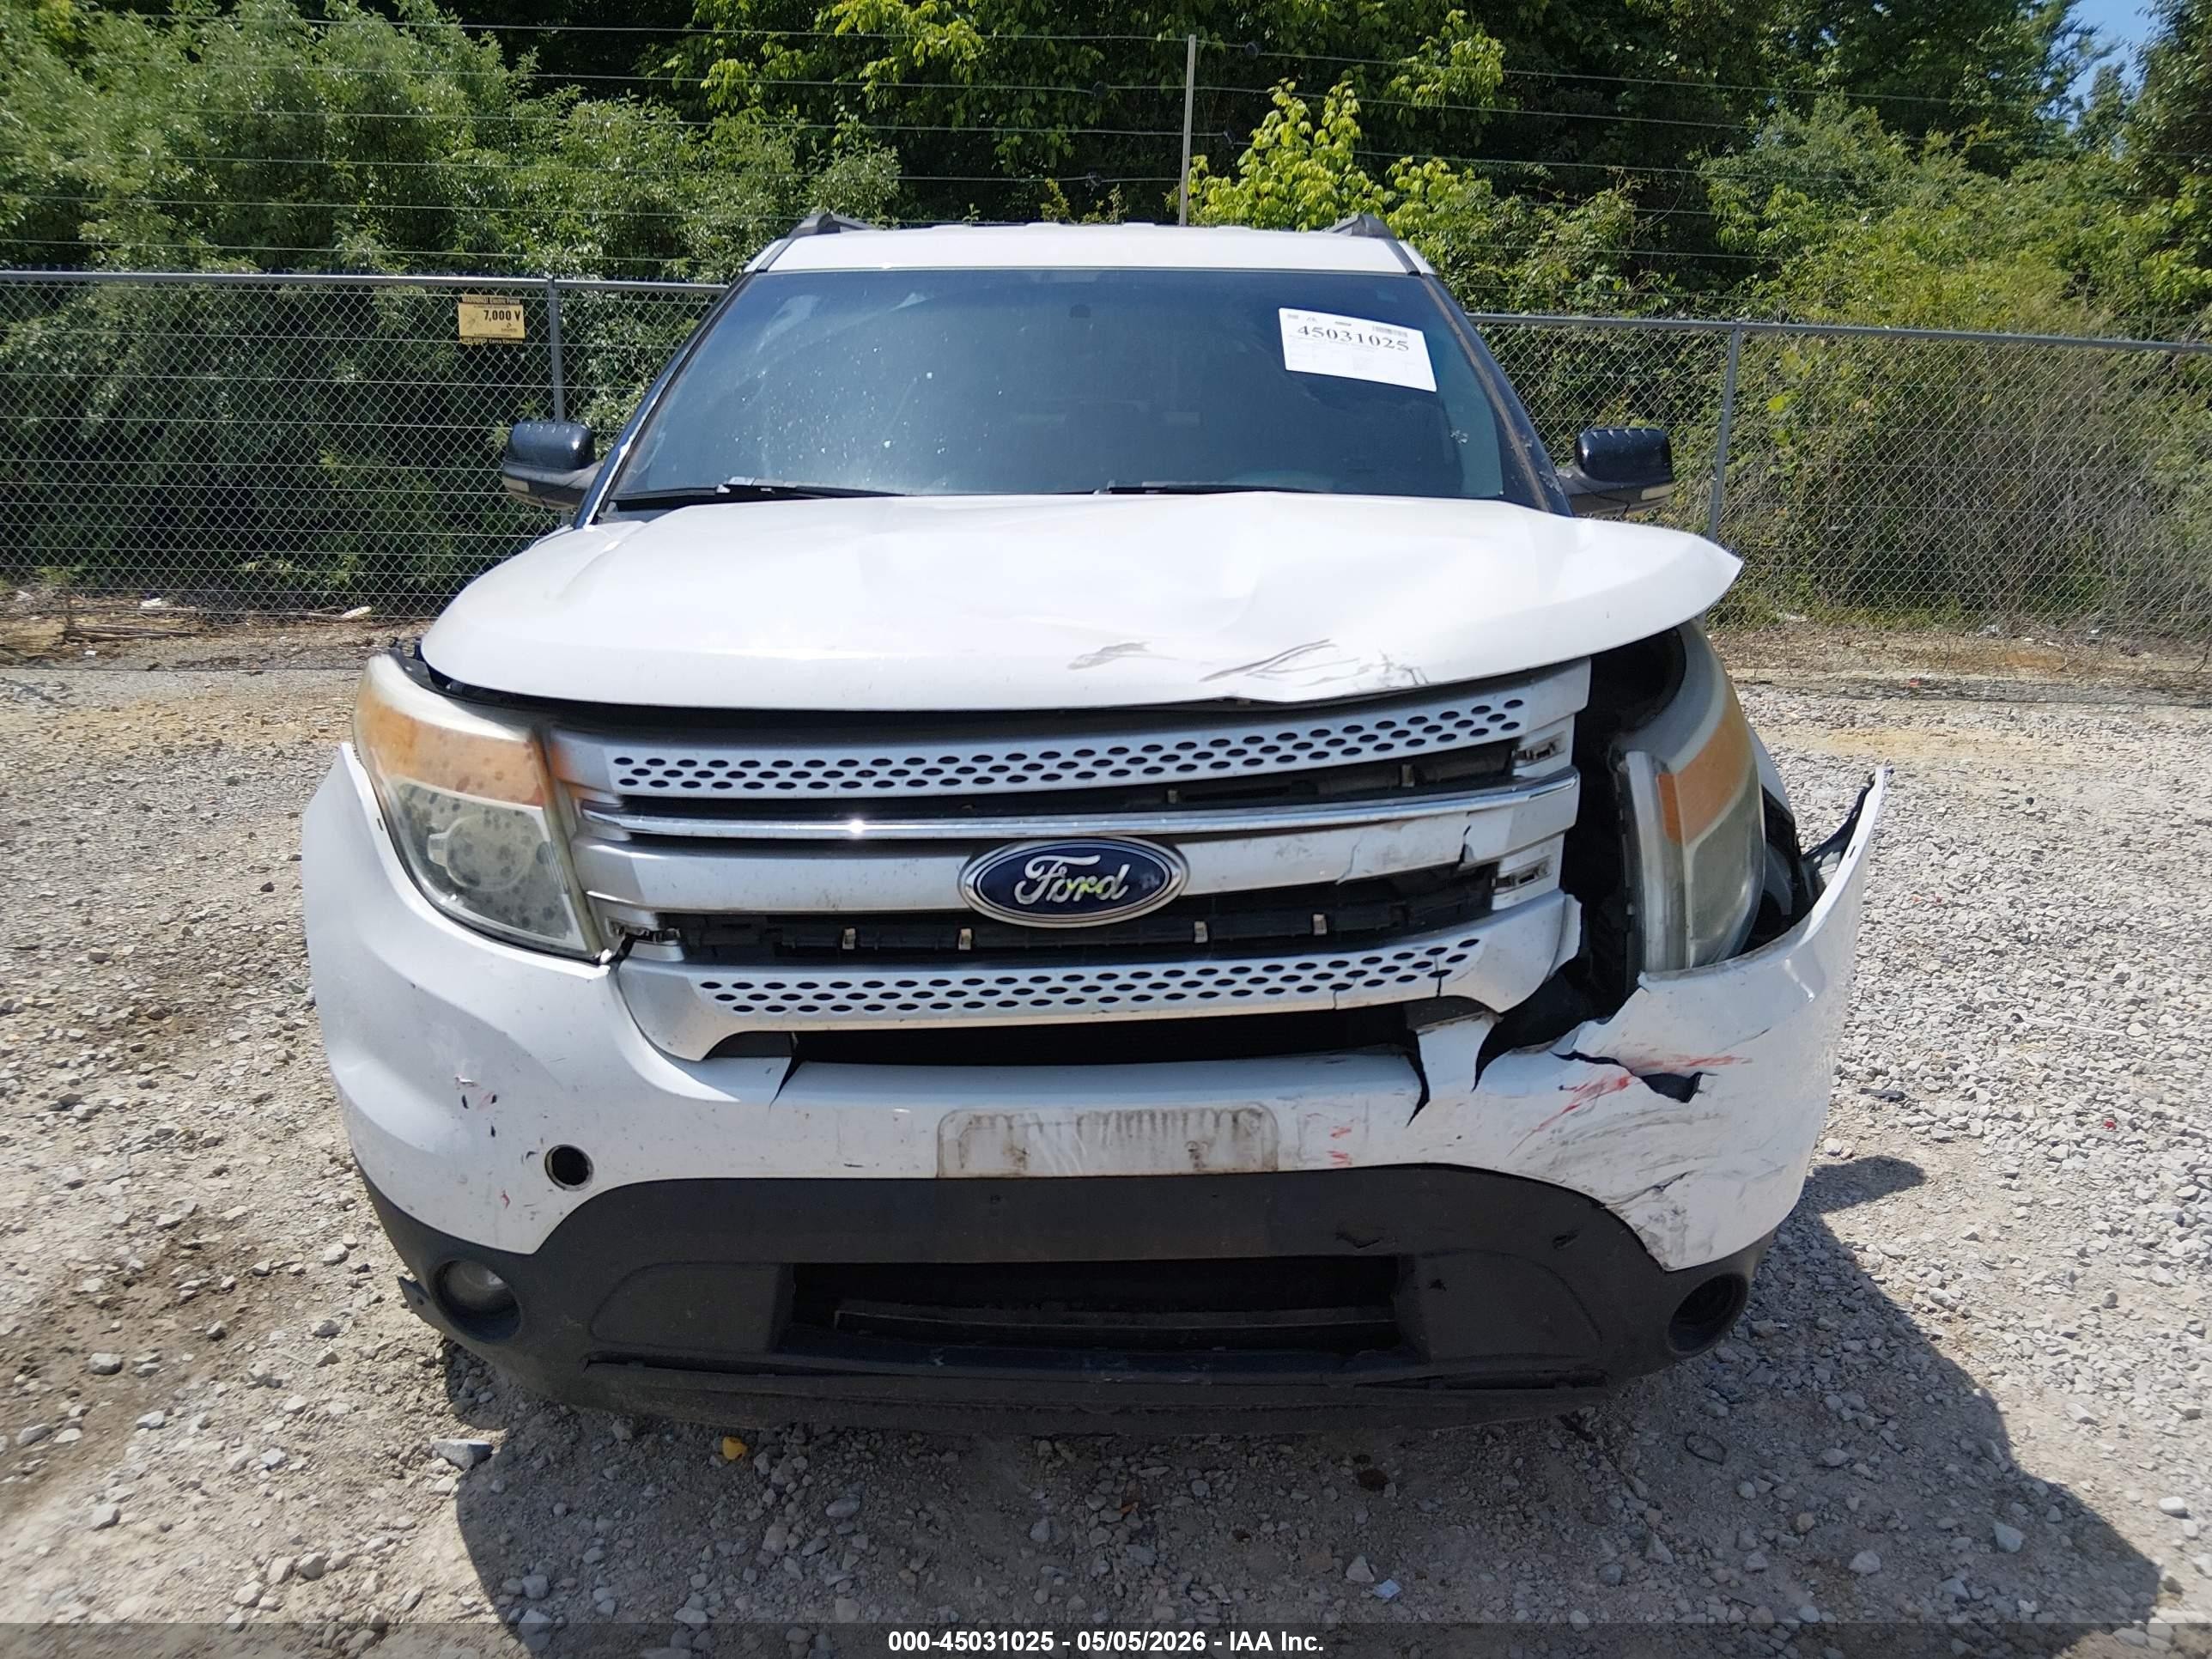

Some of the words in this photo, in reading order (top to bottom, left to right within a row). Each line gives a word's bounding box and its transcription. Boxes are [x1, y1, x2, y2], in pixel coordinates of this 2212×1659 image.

[483, 309, 512, 322] 7,000
[514, 310, 521, 321] V
[1297, 325, 1410, 352] 45031025
[1013, 854, 1131, 905] Ford
